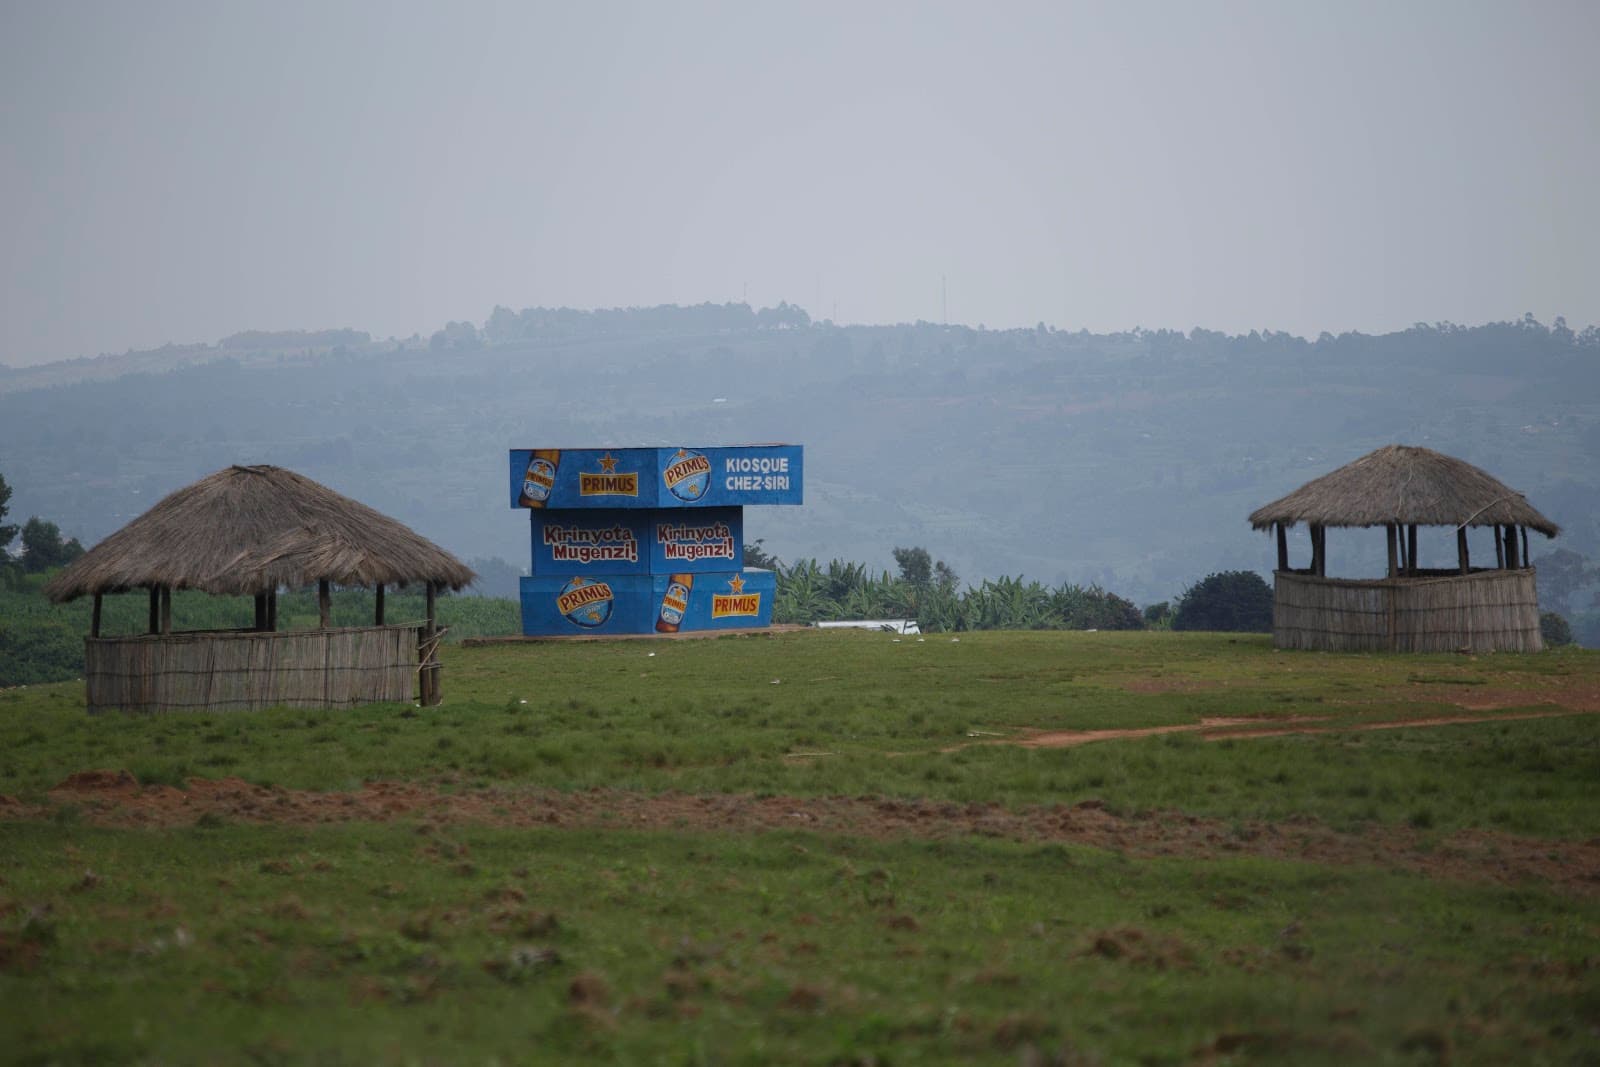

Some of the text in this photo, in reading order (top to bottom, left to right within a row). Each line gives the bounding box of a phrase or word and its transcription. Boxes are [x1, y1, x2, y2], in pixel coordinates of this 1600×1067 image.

[667, 456, 709, 483] PRIMUS
[726, 458, 789, 473] KIOSQUE
[583, 477, 634, 491] PRIMUS
[553, 540, 638, 563] Mugenzi!
[665, 537, 734, 561] Mugenzi!
[560, 585, 611, 611] PRIMUS
[714, 598, 757, 612] PRIMUS
